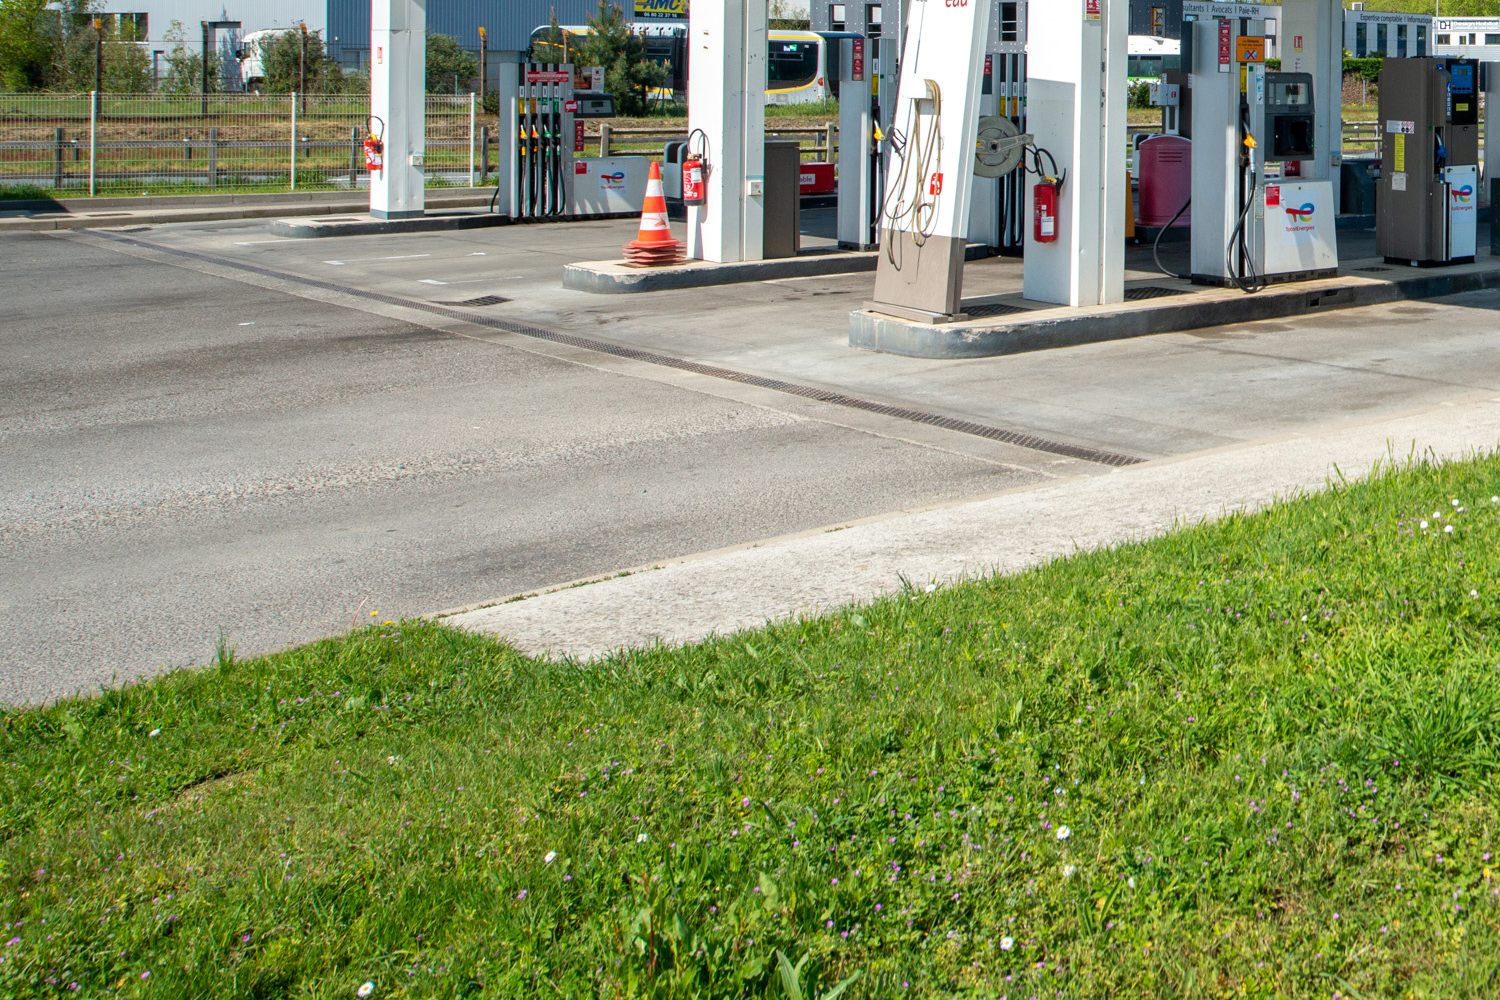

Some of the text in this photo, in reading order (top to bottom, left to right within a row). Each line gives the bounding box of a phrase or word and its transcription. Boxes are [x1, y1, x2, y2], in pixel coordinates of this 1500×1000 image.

[1183, 3, 1260, 15] sultants Avocats Paie-RH
[1360, 13, 1380, 22] Expertise
[1381, 14, 1403, 23] comptable
